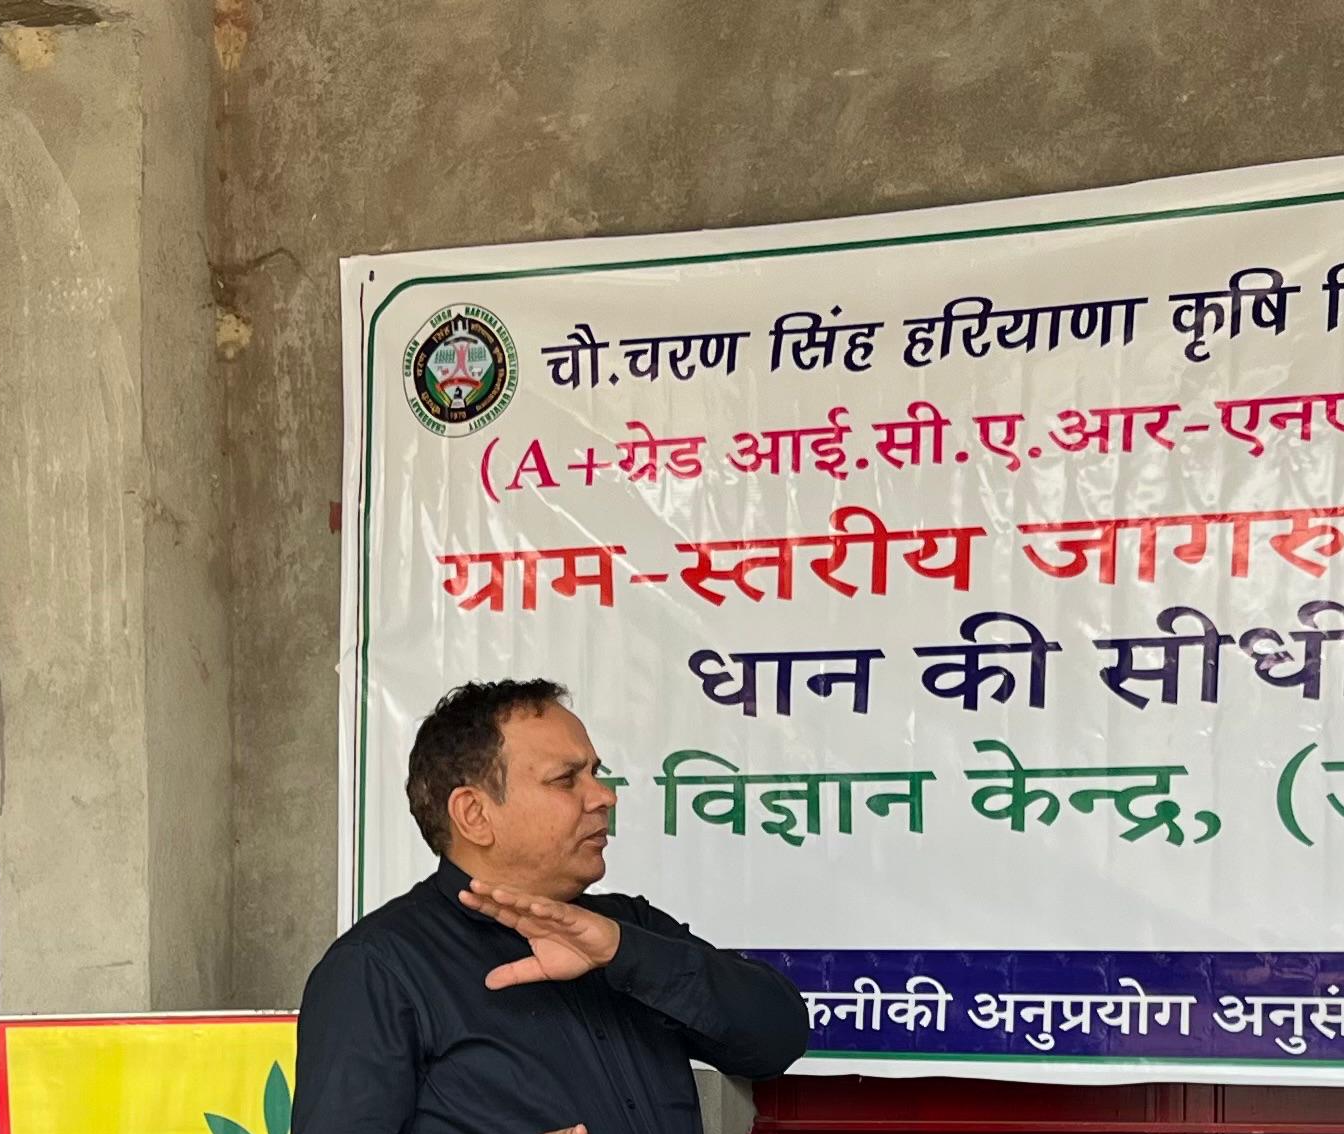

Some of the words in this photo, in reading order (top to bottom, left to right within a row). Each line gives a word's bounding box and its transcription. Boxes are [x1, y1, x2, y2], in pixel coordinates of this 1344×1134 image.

[542, 323, 750, 391] चौ.चरण
[768, 305, 879, 373] सिंह
[904, 295, 1148, 368] हरियाणा
[1169, 266, 1299, 360] कृषि
[438, 506, 986, 613] ग्राम-स्तरीय
[688, 649, 885, 717] धान
[913, 611, 1061, 710] की
[655, 749, 935, 847] विज्ञान
[965, 740, 1221, 845] केन्द्र,
[800, 976, 953, 1031] कनीकी
[967, 978, 1196, 1050] अनुप्रयोग
